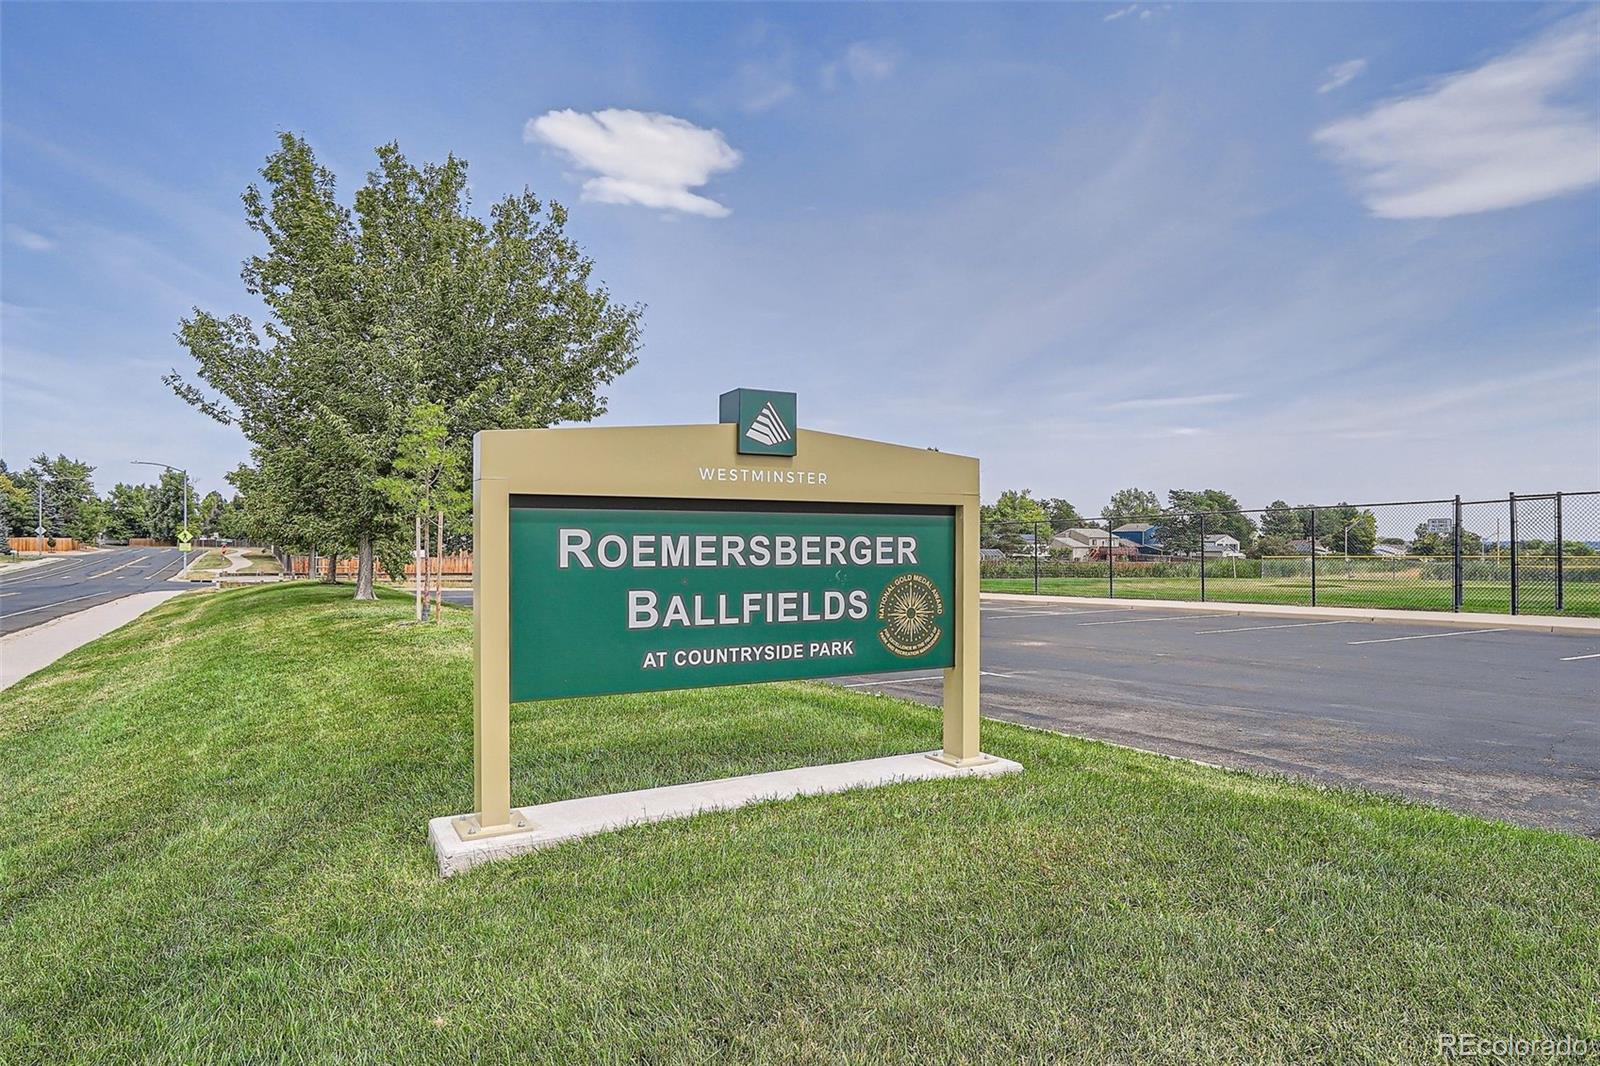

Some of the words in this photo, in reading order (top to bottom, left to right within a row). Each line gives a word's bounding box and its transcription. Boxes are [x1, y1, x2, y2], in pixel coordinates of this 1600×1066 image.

[699, 467, 827, 484] WESTMINSTER
[559, 528, 918, 568] ROEMERSBERGER
[628, 590, 868, 629] BALLFIELDS
[878, 584, 896, 619] NATIONAL
[894, 574, 912, 586] GOLD
[913, 574, 932, 589] MEDAL
[931, 588, 943, 615] AWARD
[643, 652, 668, 668] AT
[674, 643, 804, 666] COUNTRYSIDE
[810, 640, 854, 657] PARK
